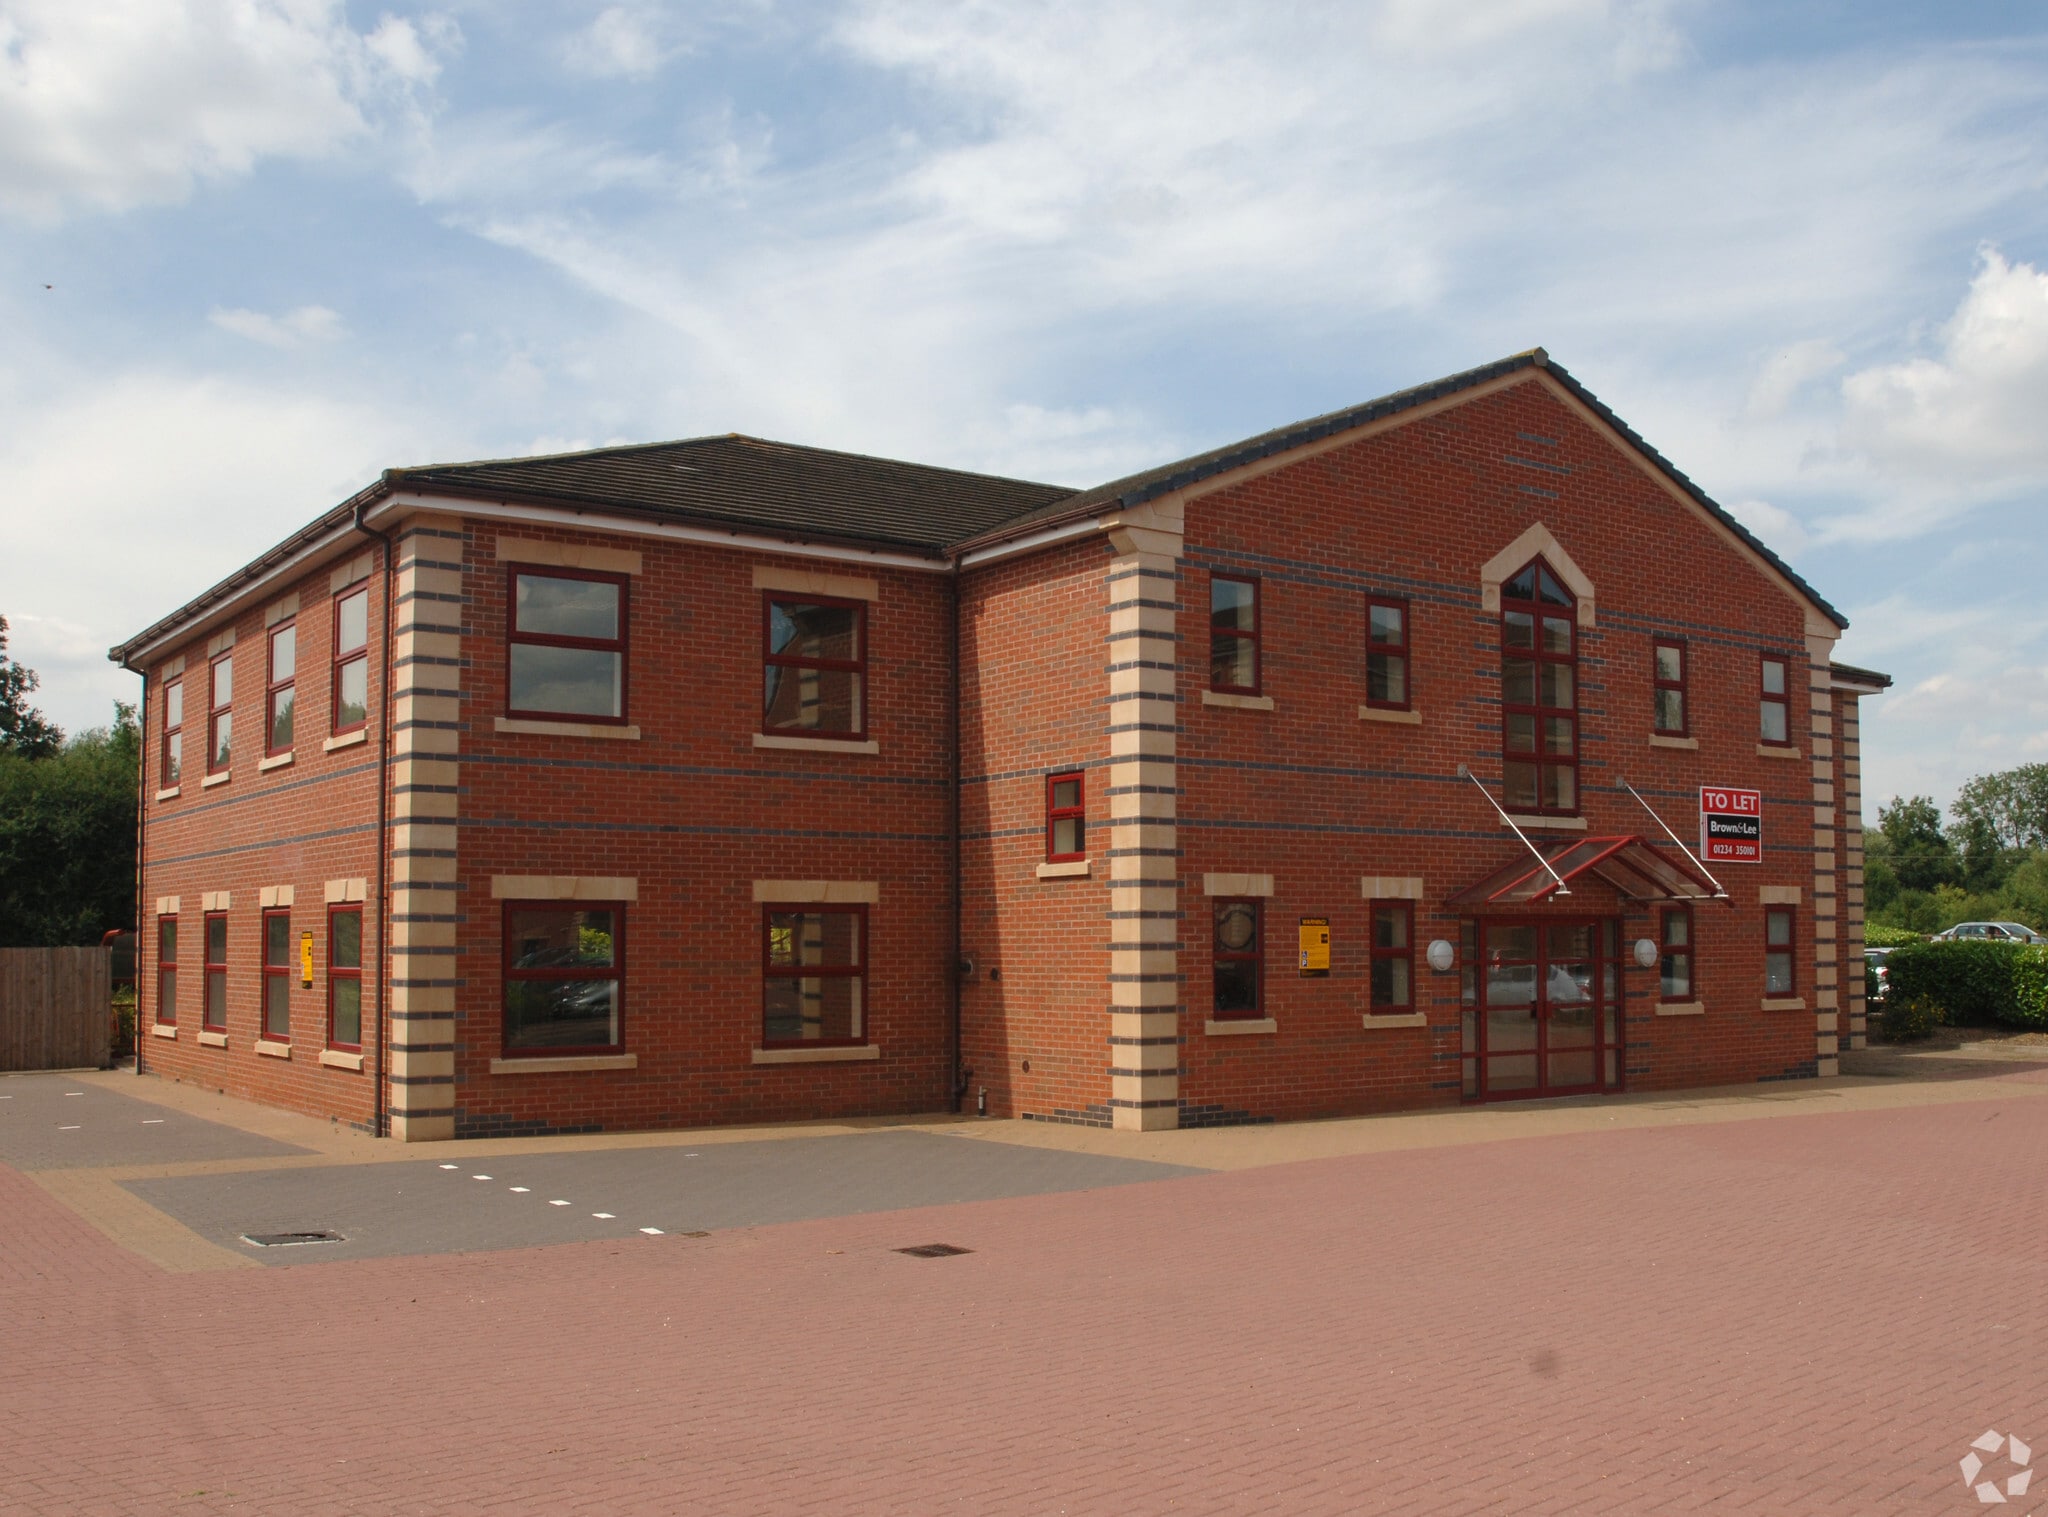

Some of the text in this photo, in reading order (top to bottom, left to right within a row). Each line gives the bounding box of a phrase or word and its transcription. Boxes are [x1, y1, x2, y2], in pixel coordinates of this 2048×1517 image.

[1705, 793, 1757, 811] TO LET
[1713, 844, 1733, 854] 01234
